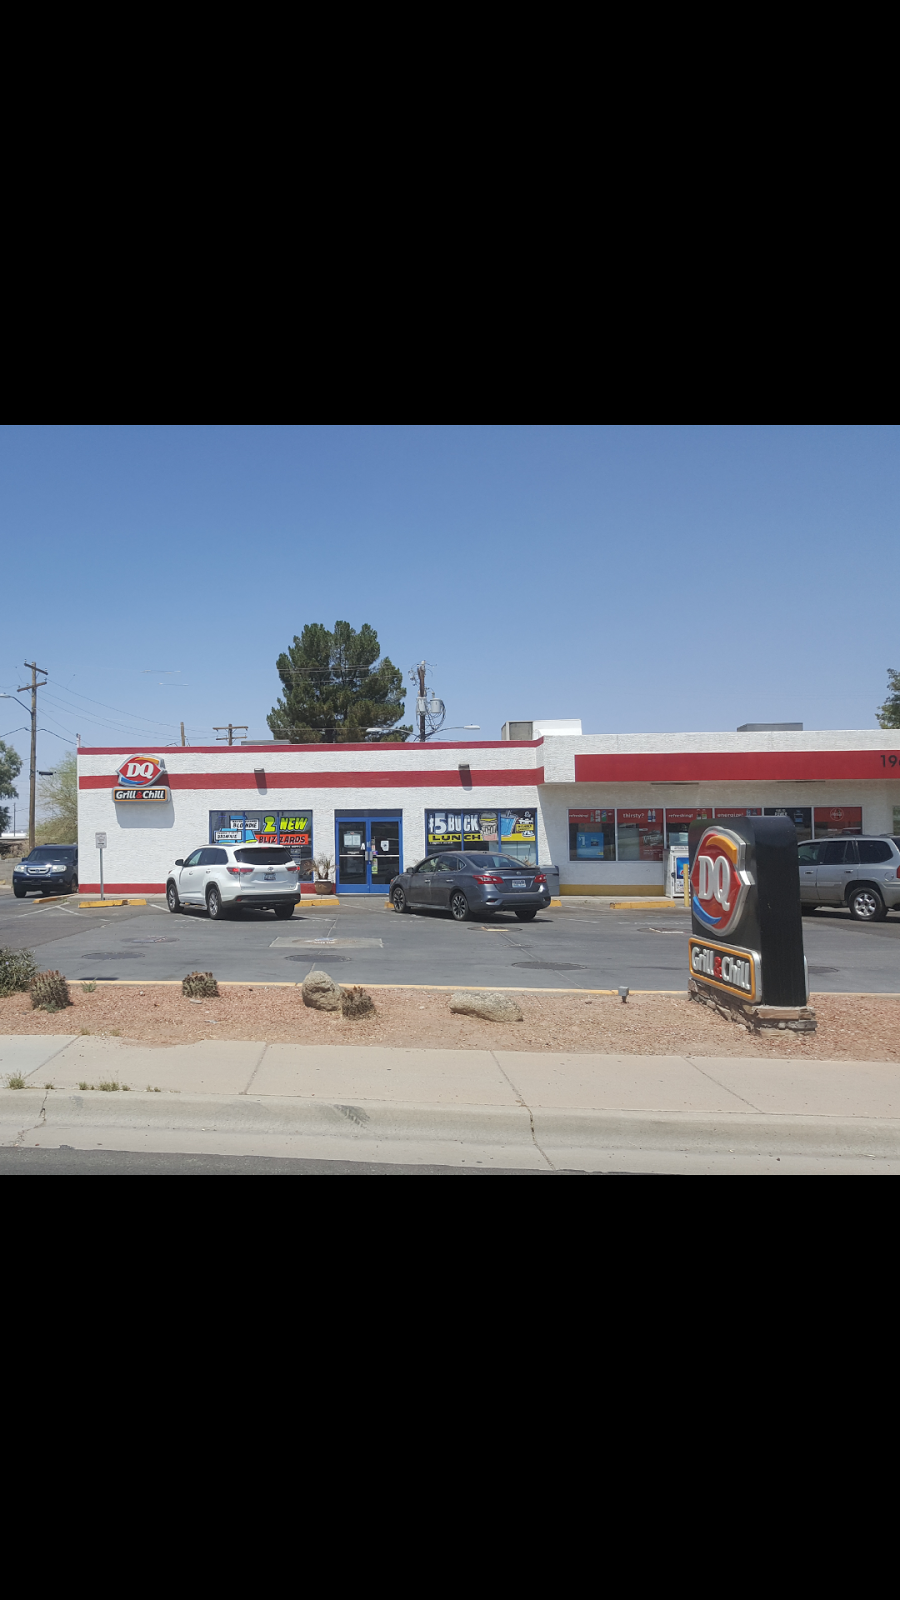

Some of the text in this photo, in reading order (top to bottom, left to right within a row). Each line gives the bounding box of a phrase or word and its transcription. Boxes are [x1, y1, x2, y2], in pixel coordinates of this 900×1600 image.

[880, 755, 900, 768] 19
[126, 762, 154, 779] DQ
[263, 816, 308, 832] 2 NEW
[447, 814, 480, 832] BUCK
[623, 812, 645, 820] thirsty?
[258, 835, 306, 844] BLIZZARDS
[698, 855, 731, 911] DQ
